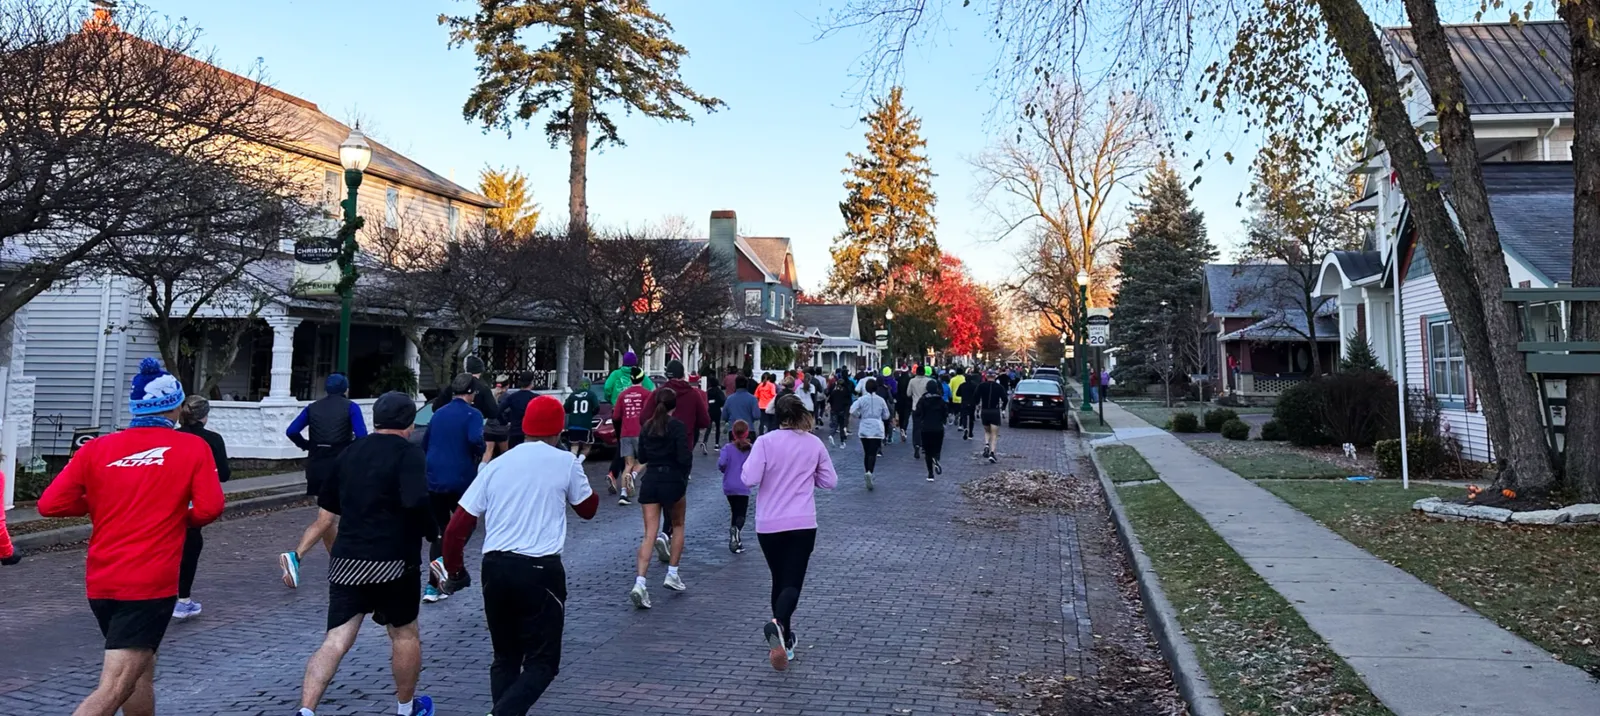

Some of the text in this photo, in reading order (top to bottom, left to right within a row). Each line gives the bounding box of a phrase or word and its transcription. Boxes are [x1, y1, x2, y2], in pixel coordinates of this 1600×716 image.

[1090, 336, 1104, 344] 20
[573, 399, 589, 414] 10
[105, 457, 165, 468] ALTRA
